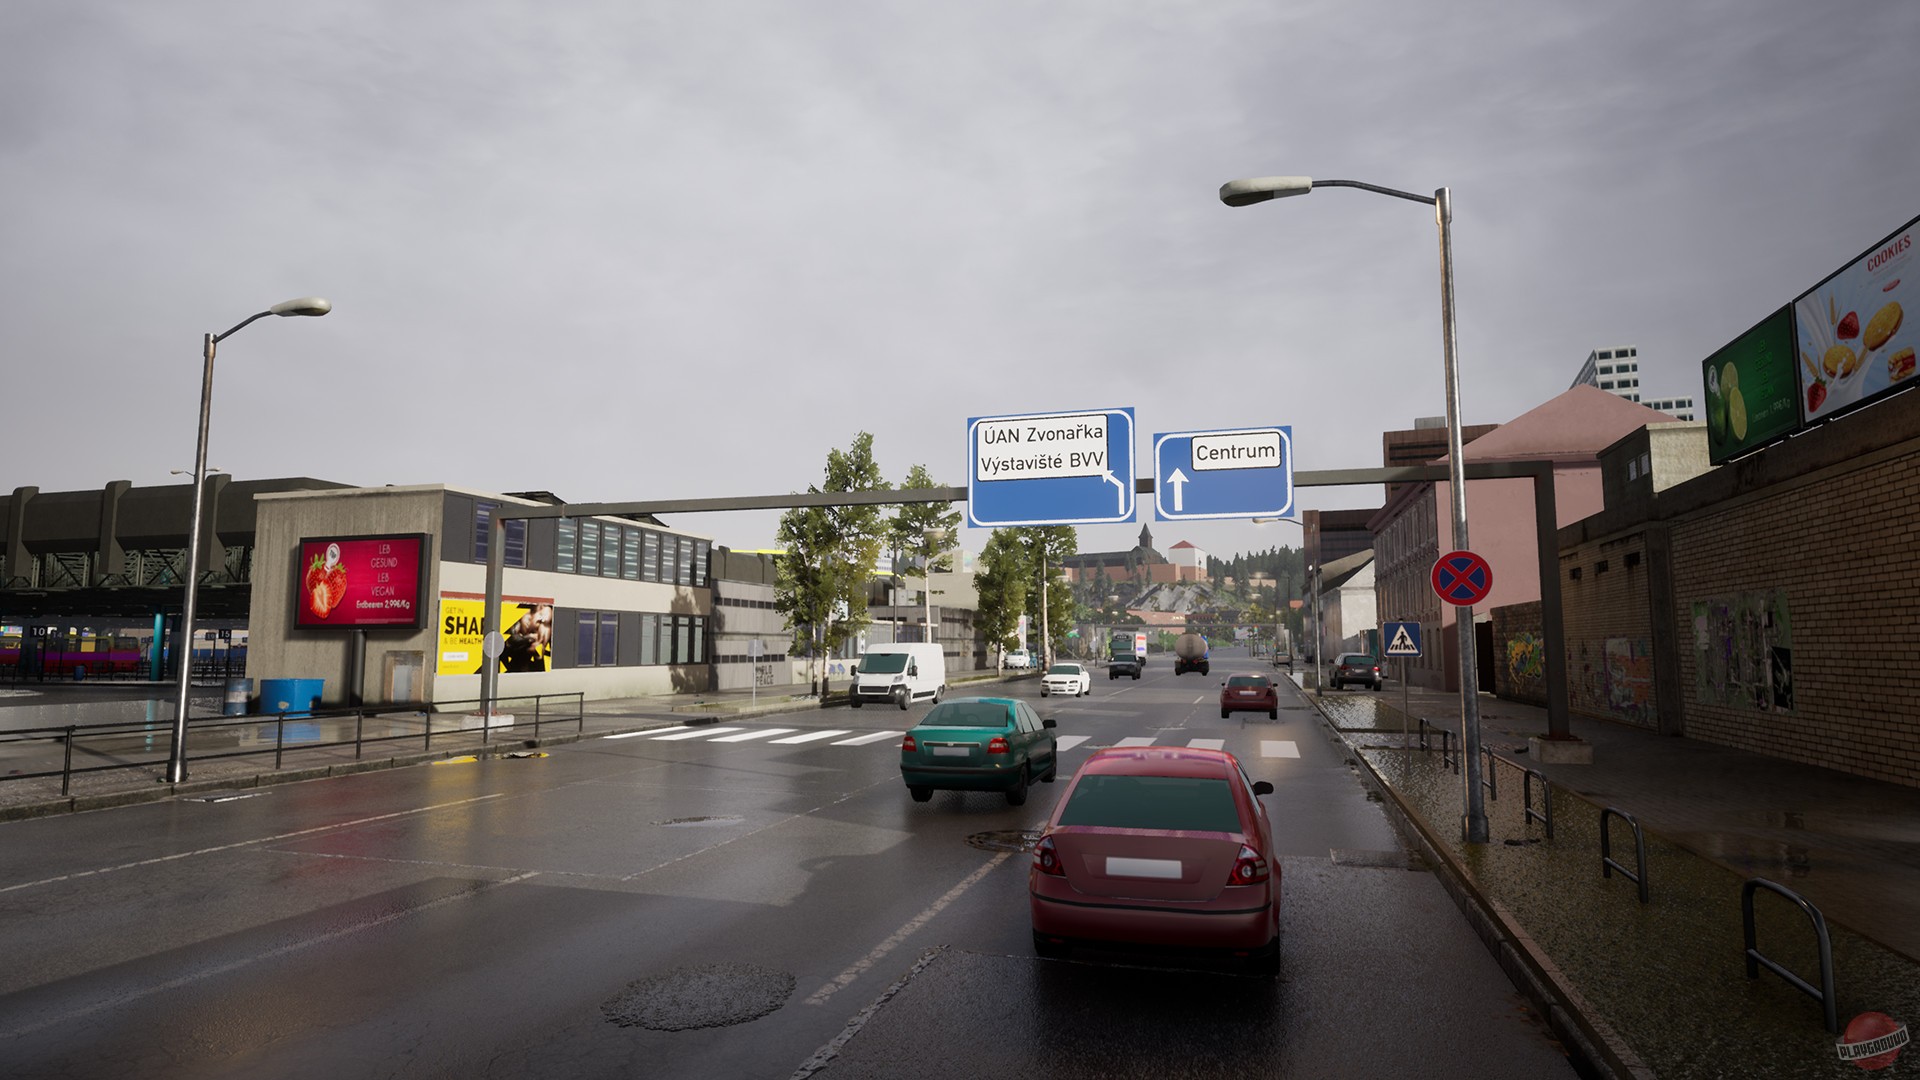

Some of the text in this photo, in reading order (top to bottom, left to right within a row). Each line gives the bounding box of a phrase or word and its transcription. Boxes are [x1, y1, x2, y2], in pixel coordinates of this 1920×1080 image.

[1867, 234, 1911, 272] COOKIES
[984, 424, 1103, 445] ÚAN Zvonařka
[1196, 445, 1276, 461] Centrum
[981, 452, 1104, 475] Výstaviště BVV
[379, 544, 390, 555] LEB
[370, 557, 398, 568] GESUND
[377, 572, 390, 583] LEB
[371, 586, 395, 596] VEGAN
[445, 606, 457, 614] GET
[32, 627, 46, 636] 10
[220, 630, 231, 638] 15
